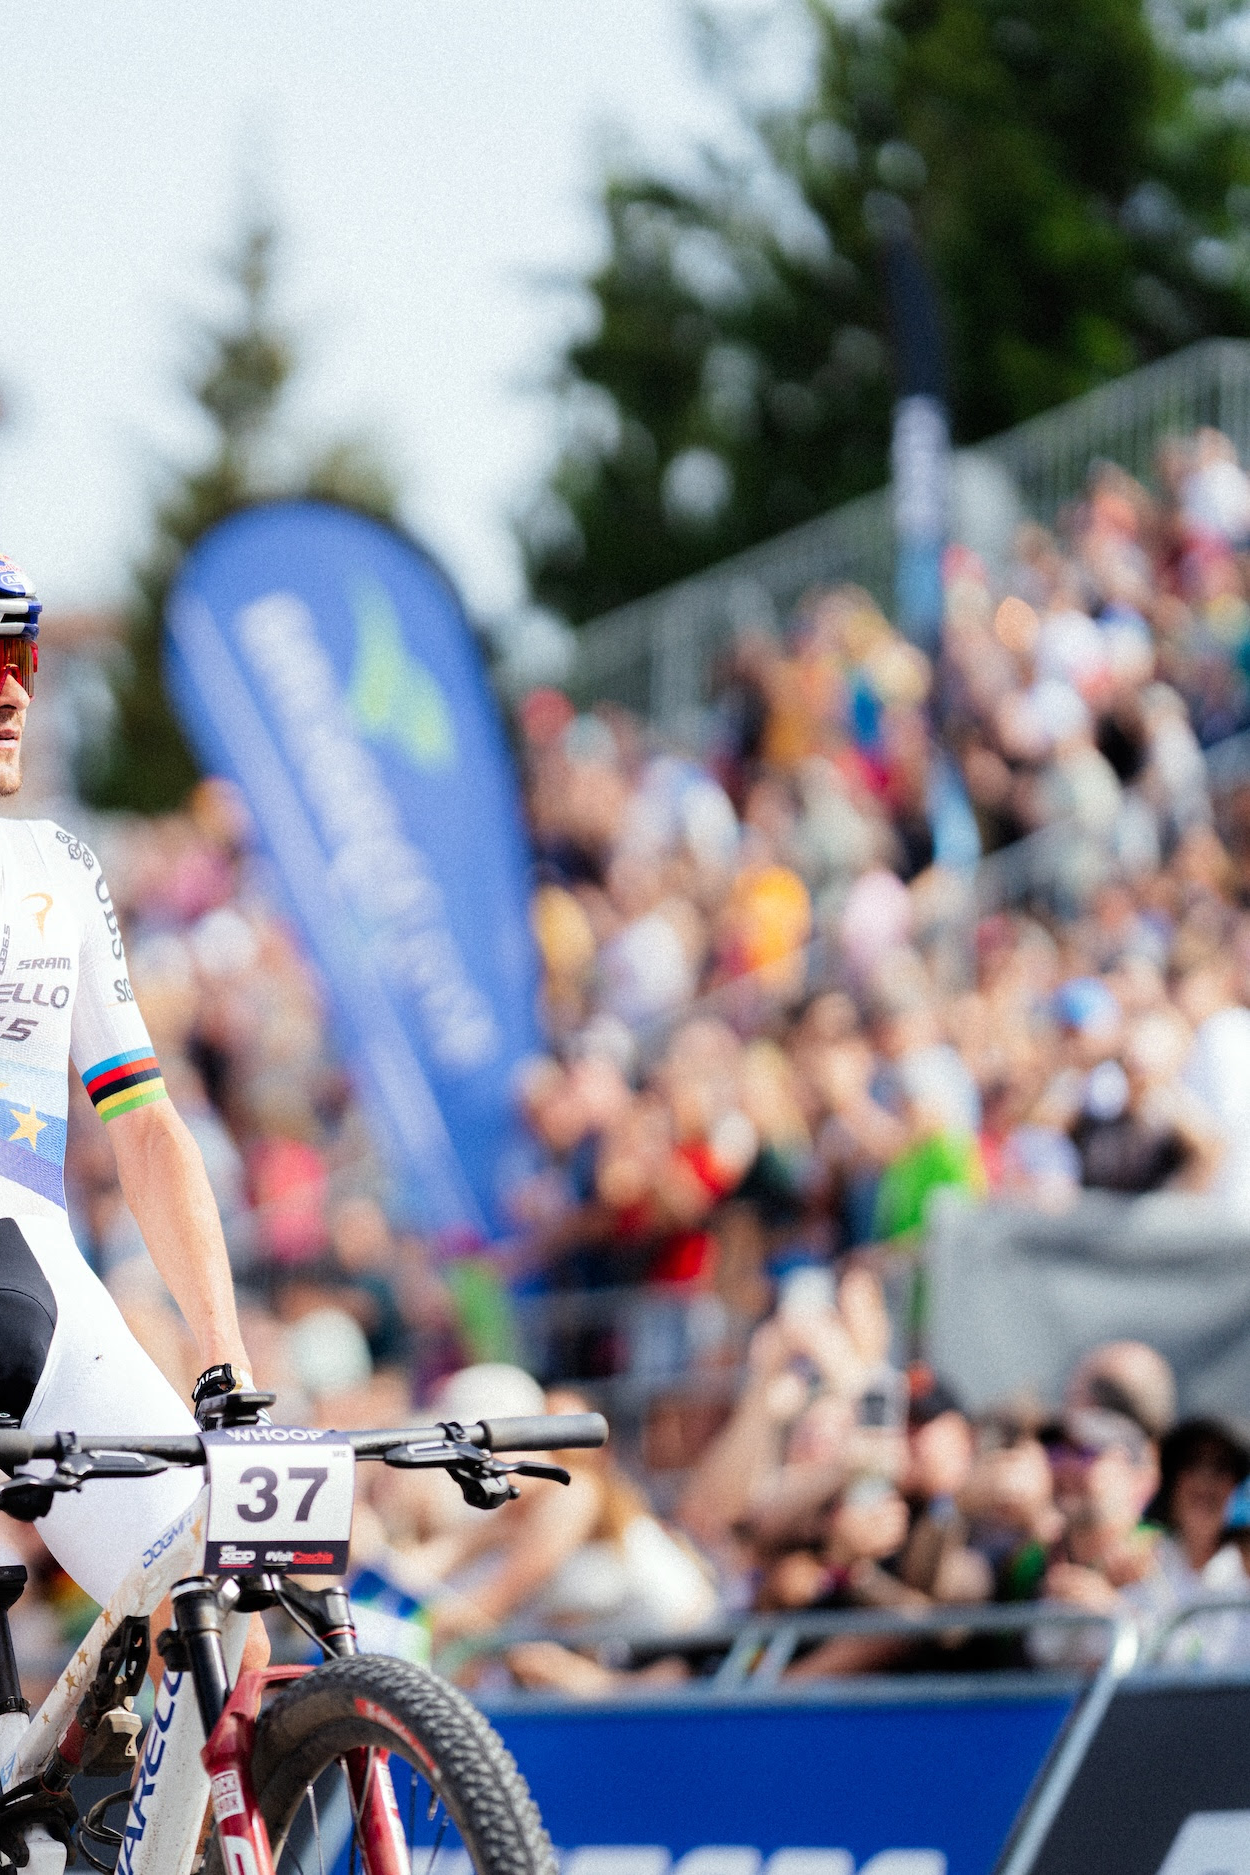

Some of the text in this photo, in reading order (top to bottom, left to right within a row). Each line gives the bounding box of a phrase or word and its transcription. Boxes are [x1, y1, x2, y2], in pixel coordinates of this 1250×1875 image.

[16, 956, 71, 971] SRAM
[225, 1428, 326, 1442] WHOOP
[237, 1466, 329, 1523] 37
